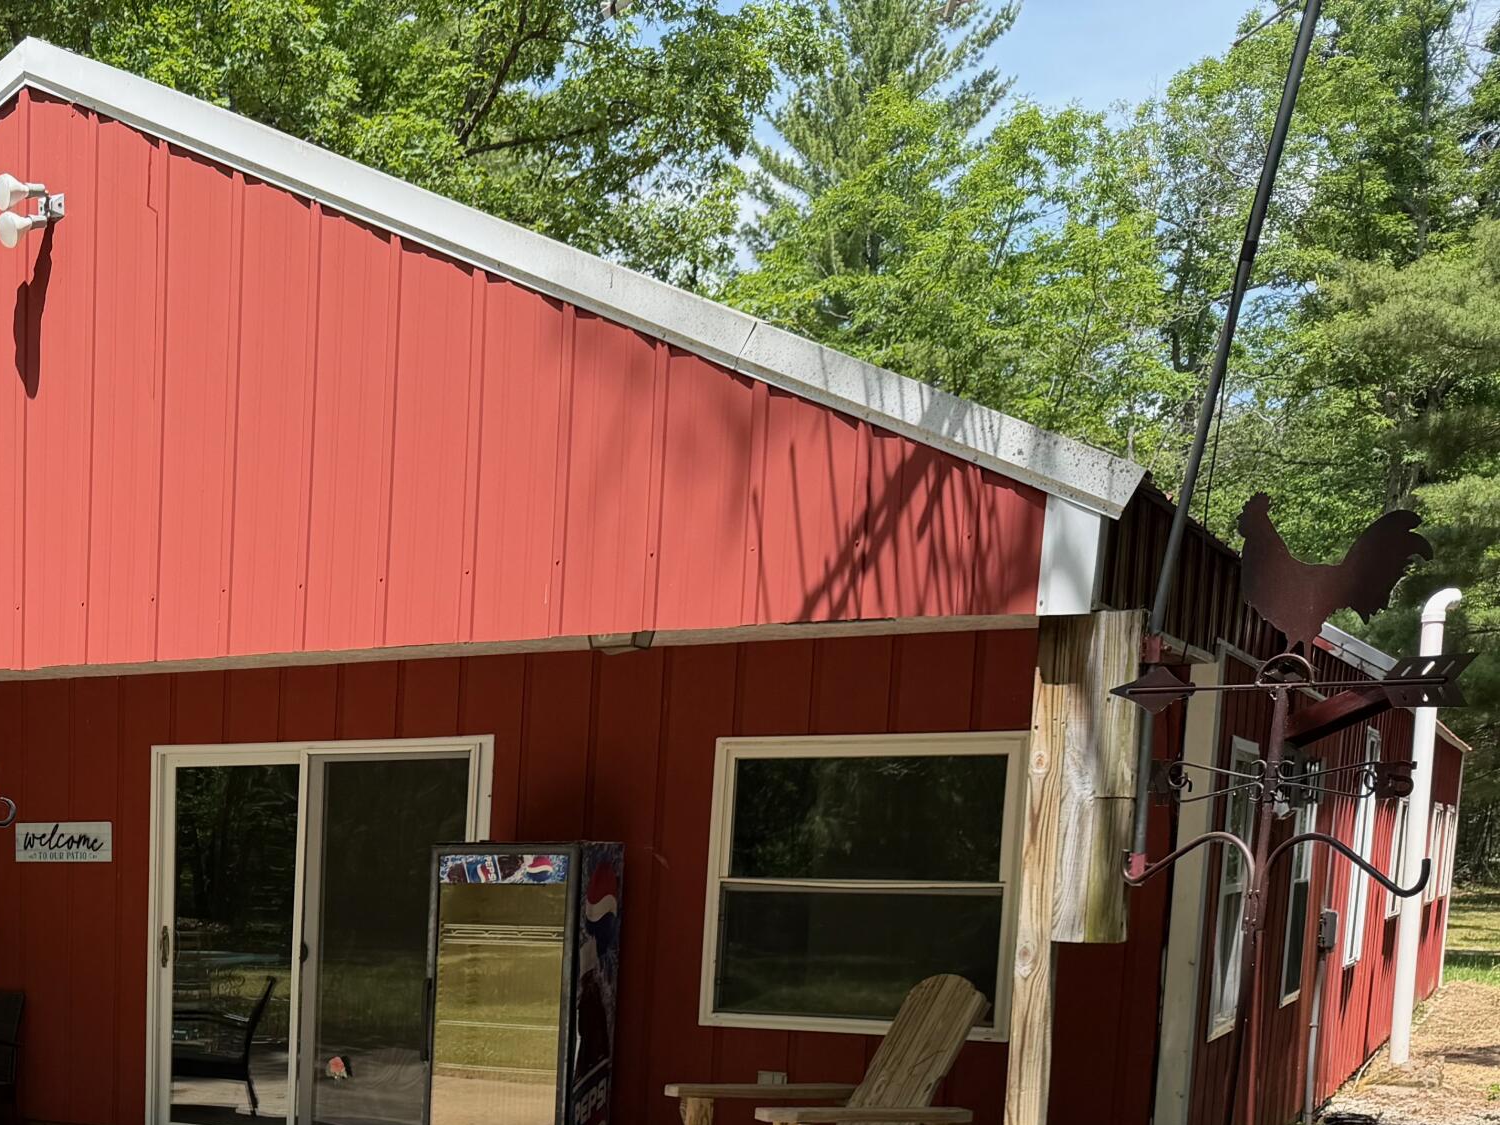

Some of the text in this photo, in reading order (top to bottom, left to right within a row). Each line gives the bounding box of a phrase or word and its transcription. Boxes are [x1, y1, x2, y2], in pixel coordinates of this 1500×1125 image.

[23, 823, 104, 851] welcome
[38, 851, 87, 860] TO OUR PATIO
[482, 855, 498, 882] PEPSI
[574, 1073, 607, 1117] PEPSI
